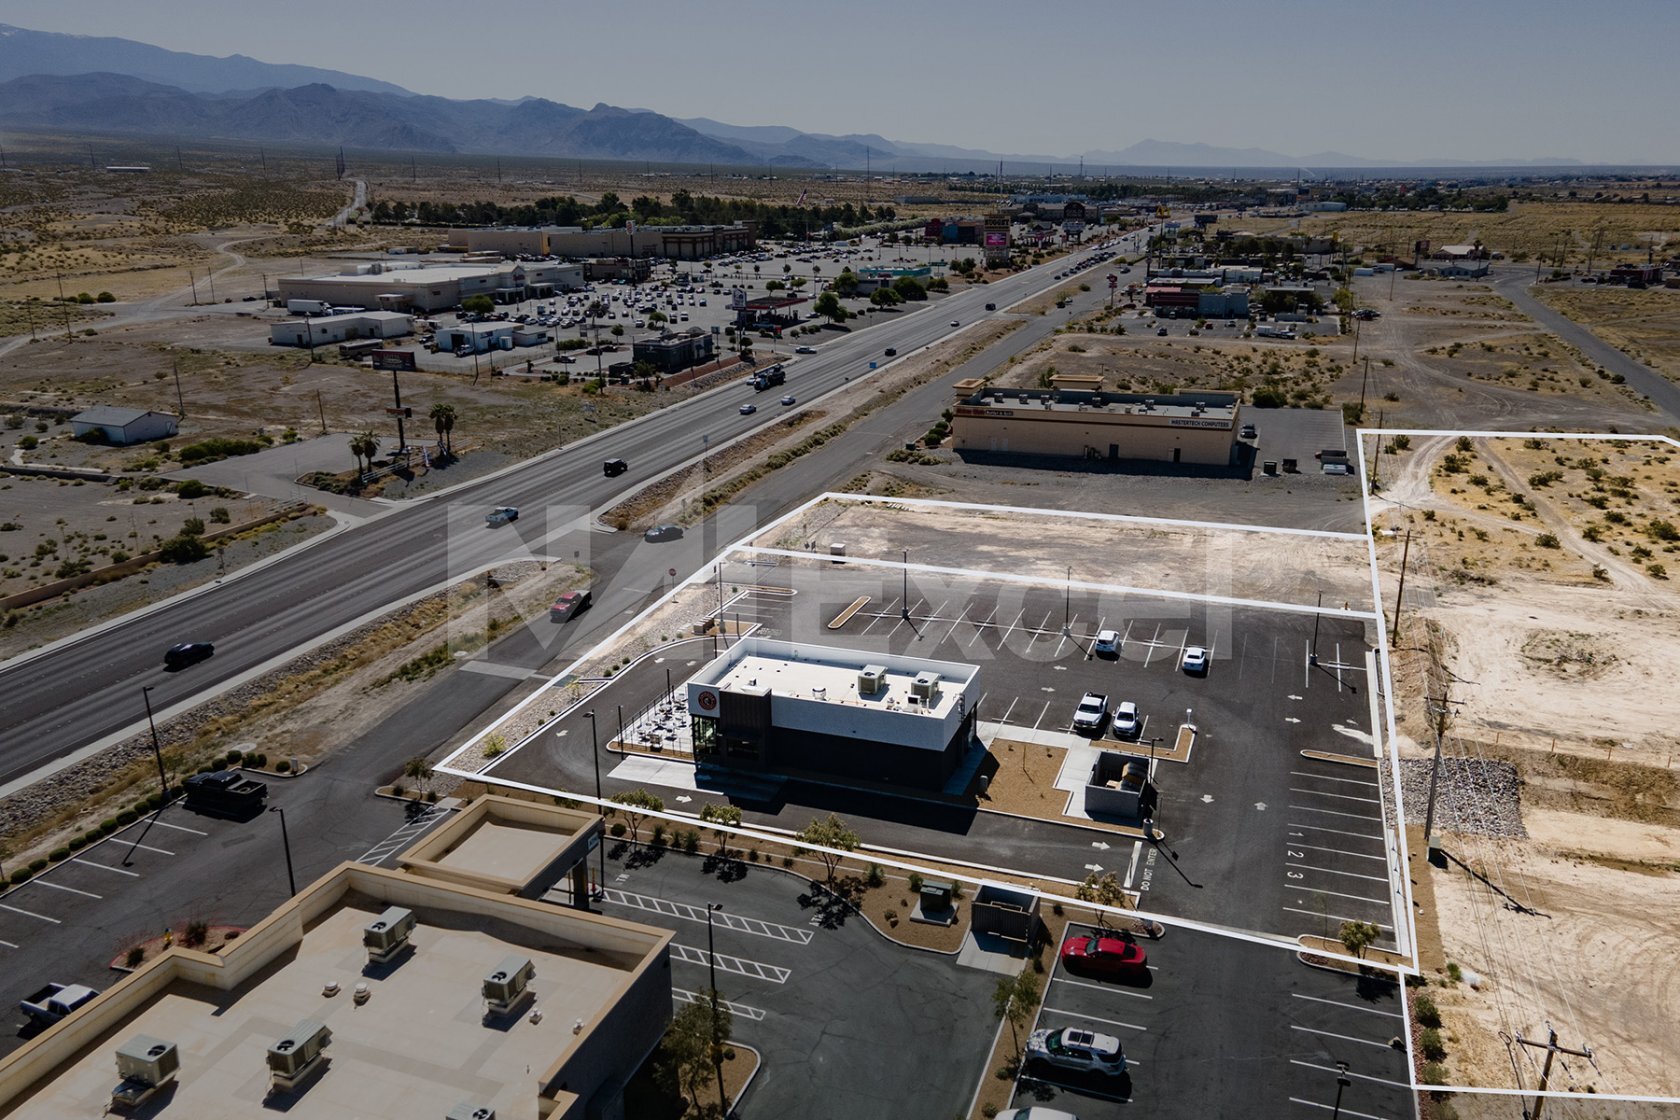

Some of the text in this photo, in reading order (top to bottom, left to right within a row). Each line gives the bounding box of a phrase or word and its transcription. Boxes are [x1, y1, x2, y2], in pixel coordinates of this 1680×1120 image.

[1288, 850, 1304, 858] 2
[1140, 848, 1157, 891] DO NOT ENTER
[1287, 871, 1304, 879] 3
